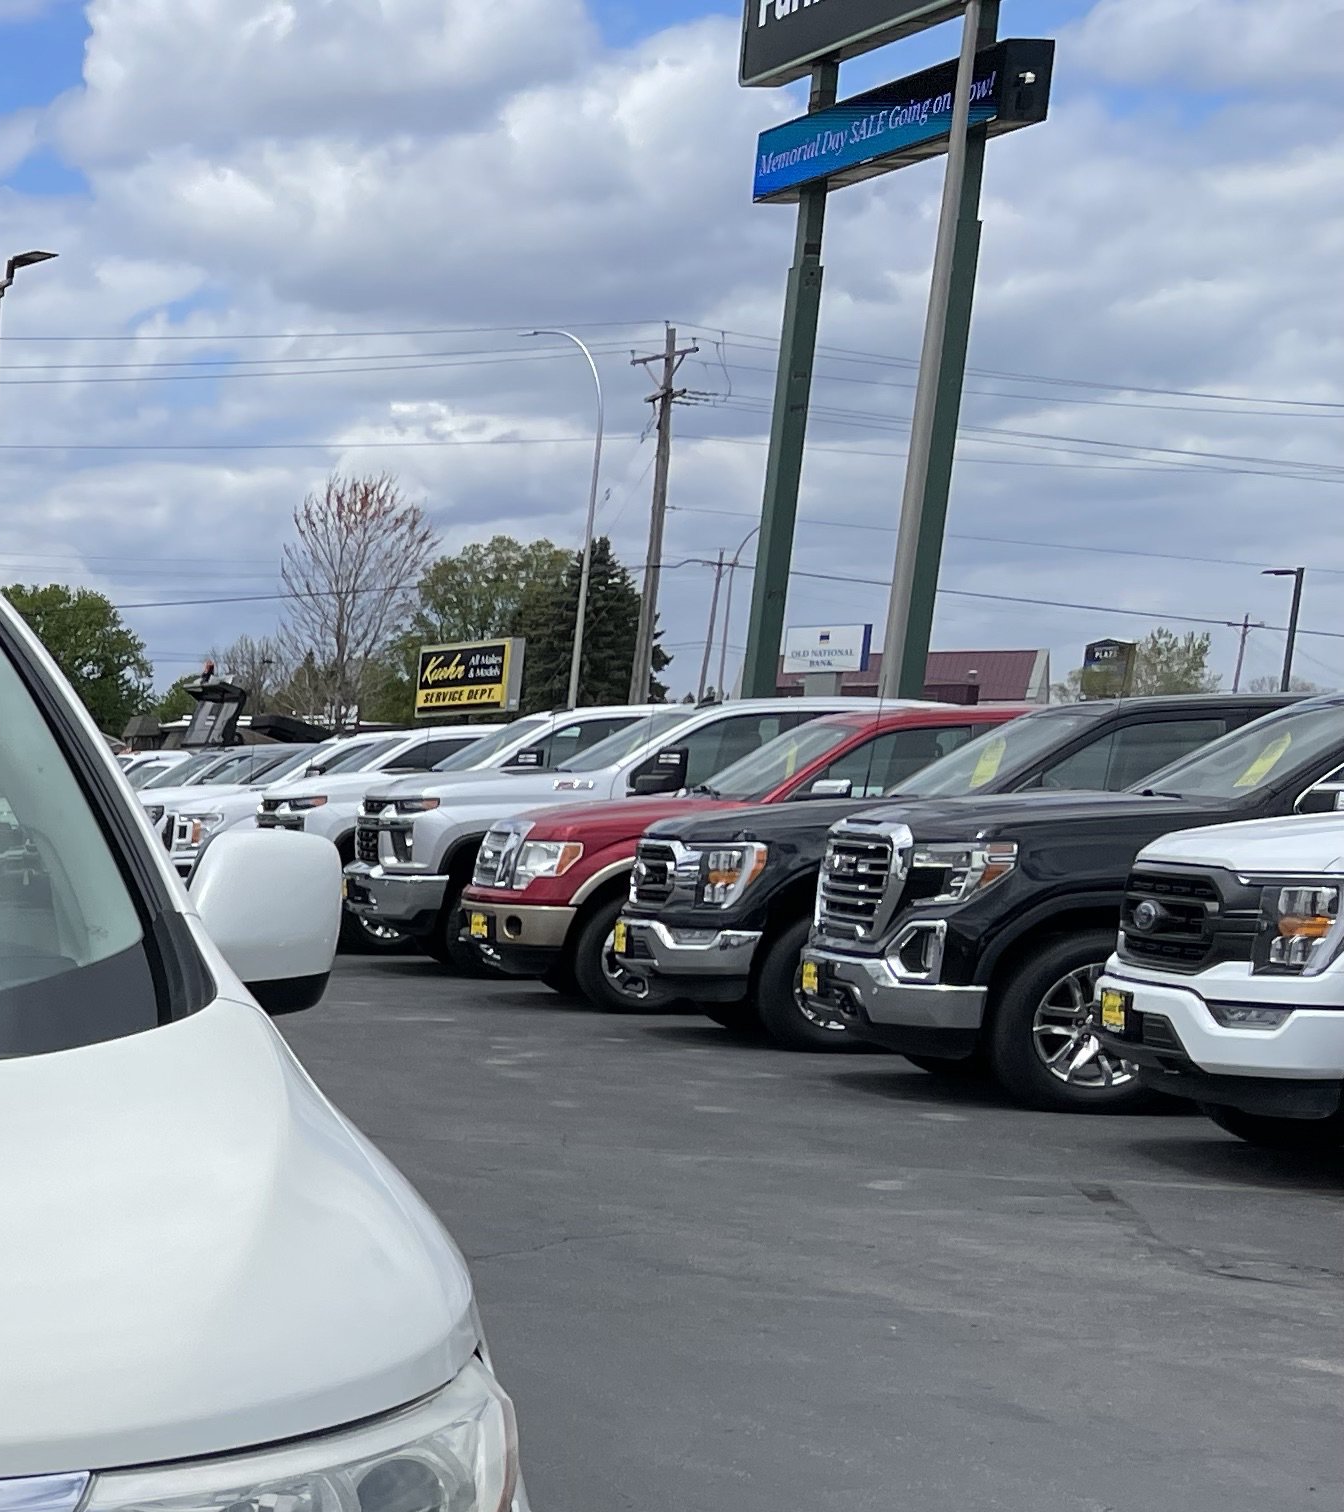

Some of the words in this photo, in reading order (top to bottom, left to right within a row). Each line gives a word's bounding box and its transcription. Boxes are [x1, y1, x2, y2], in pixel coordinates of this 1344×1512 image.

[759, 133, 820, 176] Memorial
[821, 129, 848, 156] Day
[849, 110, 888, 144] SALE
[888, 99, 933, 126] Going
[932, 91, 952, 114] on
[791, 650, 810, 659] OLD
[811, 648, 854, 658] NATIONAL
[421, 653, 466, 685] Kuehn
[423, 689, 464, 704] SERVICE
